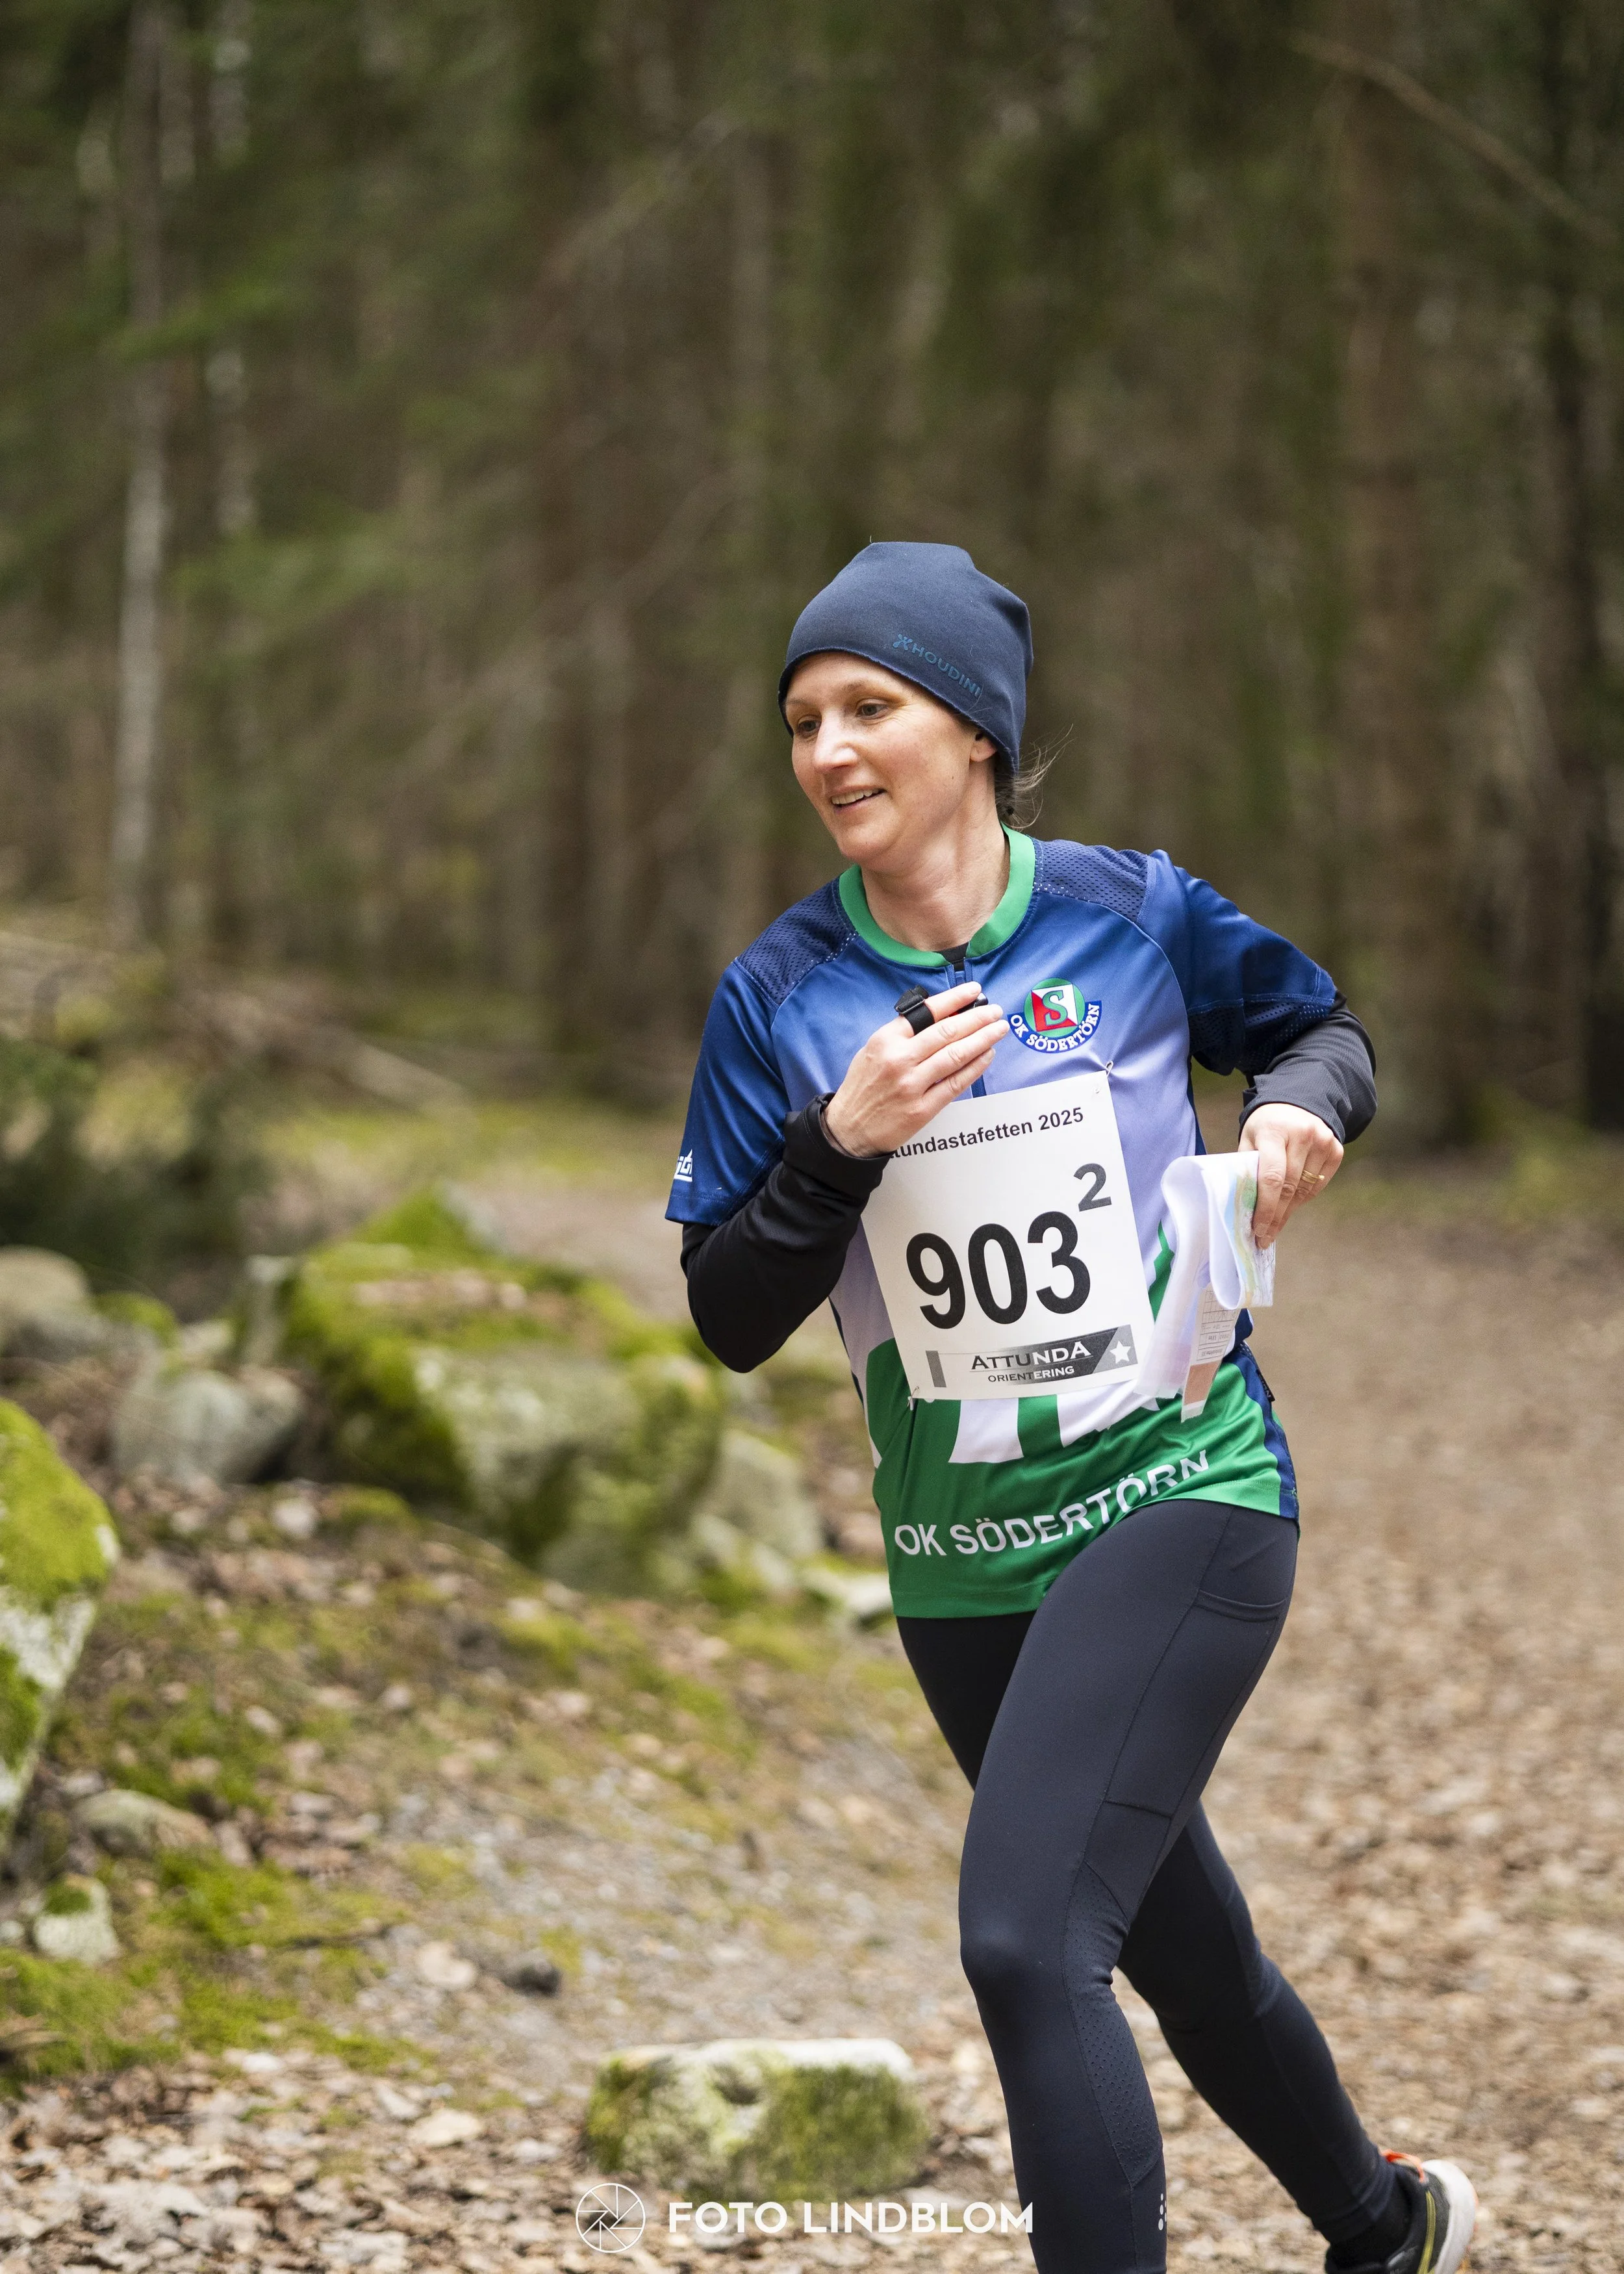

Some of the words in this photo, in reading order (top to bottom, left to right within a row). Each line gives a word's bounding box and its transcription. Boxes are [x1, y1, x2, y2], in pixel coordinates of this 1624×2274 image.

[911, 643, 982, 697] HOUDINI
[1010, 1014, 1029, 1038] OK
[1026, 1003, 1100, 1051] SÖDERTÖRN
[1042, 990, 1068, 1027] S
[889, 1120, 1033, 1158] undastafetten
[1039, 1107, 1084, 1131] 2025
[1073, 1163, 1112, 1212] 2
[906, 1211, 1091, 1329] 903
[971, 1341, 1091, 1370] ATTUNDA
[987, 1366, 1074, 1383] ORIENTERING
[894, 1523, 947, 1557] OK
[949, 1450, 1210, 1554] SÖDERTÖRN
